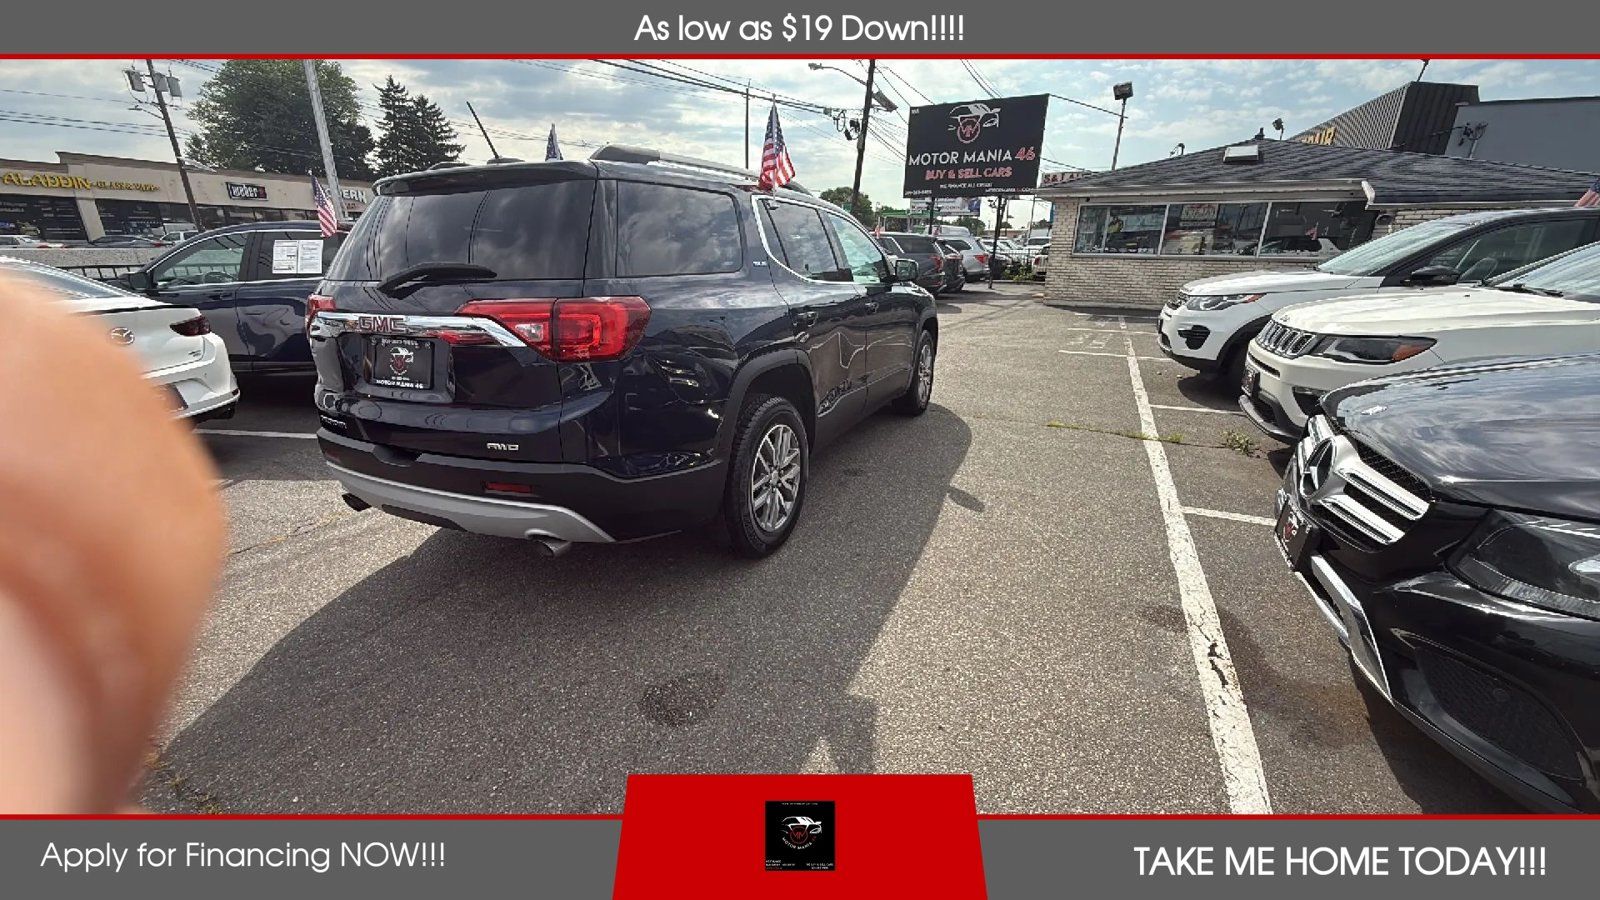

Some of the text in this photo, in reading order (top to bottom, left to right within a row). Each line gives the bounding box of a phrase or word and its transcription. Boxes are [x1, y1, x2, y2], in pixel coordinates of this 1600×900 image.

[908, 146, 1036, 166] MOTOR MANIA 46
[2, 172, 92, 190] ALADDIN
[925, 166, 1013, 180] BUY & SELL CARS
[359, 315, 406, 333] GMC
